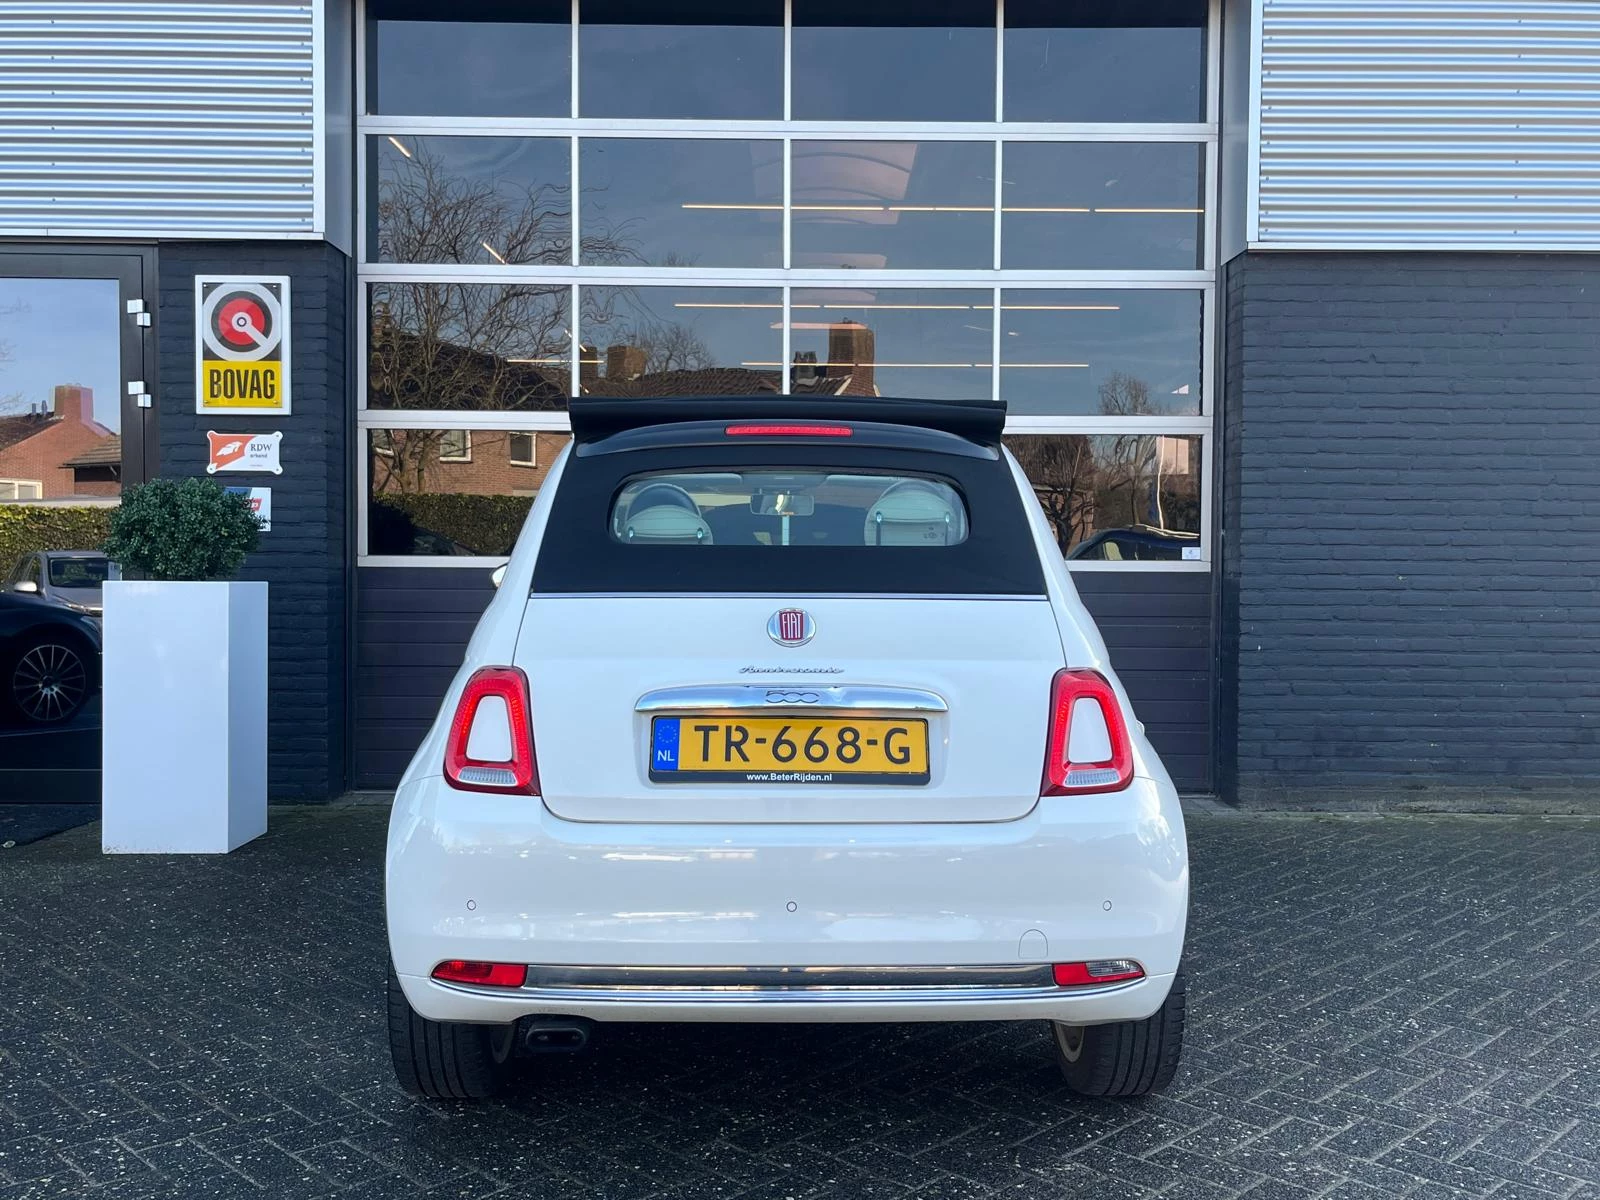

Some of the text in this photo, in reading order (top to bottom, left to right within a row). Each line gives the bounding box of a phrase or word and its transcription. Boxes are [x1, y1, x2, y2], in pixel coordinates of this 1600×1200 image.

[209, 368, 275, 400] BOVAG
[250, 443, 272, 452] RDW
[781, 612, 802, 639] FIAT
[765, 690, 820, 704] 500
[693, 724, 911, 765] TR-668-G
[657, 749, 675, 762] NL
[746, 772, 833, 782] www.BeterRijden.nl
